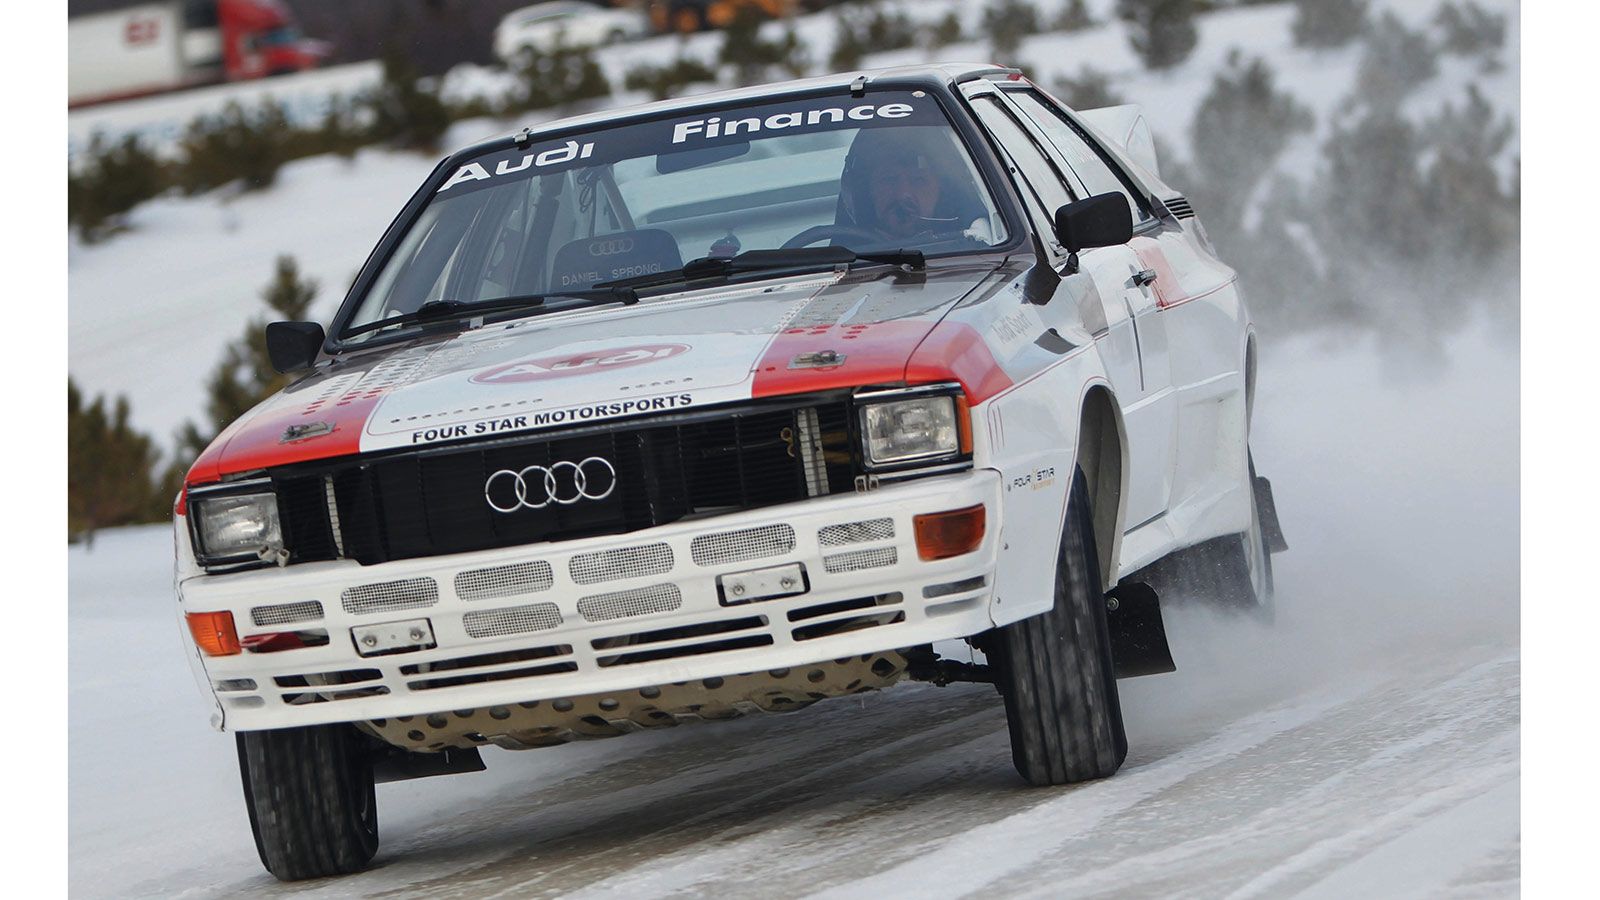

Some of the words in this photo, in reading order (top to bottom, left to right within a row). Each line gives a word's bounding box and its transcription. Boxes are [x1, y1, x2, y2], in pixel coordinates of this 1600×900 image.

[437, 141, 594, 192] Audi
[672, 102, 914, 144] Finance
[562, 272, 602, 286] DANIEL
[484, 348, 673, 381] Audi
[411, 424, 468, 444] FOUR
[474, 415, 527, 434] STAR
[534, 392, 693, 426] MOTORSPORTS
